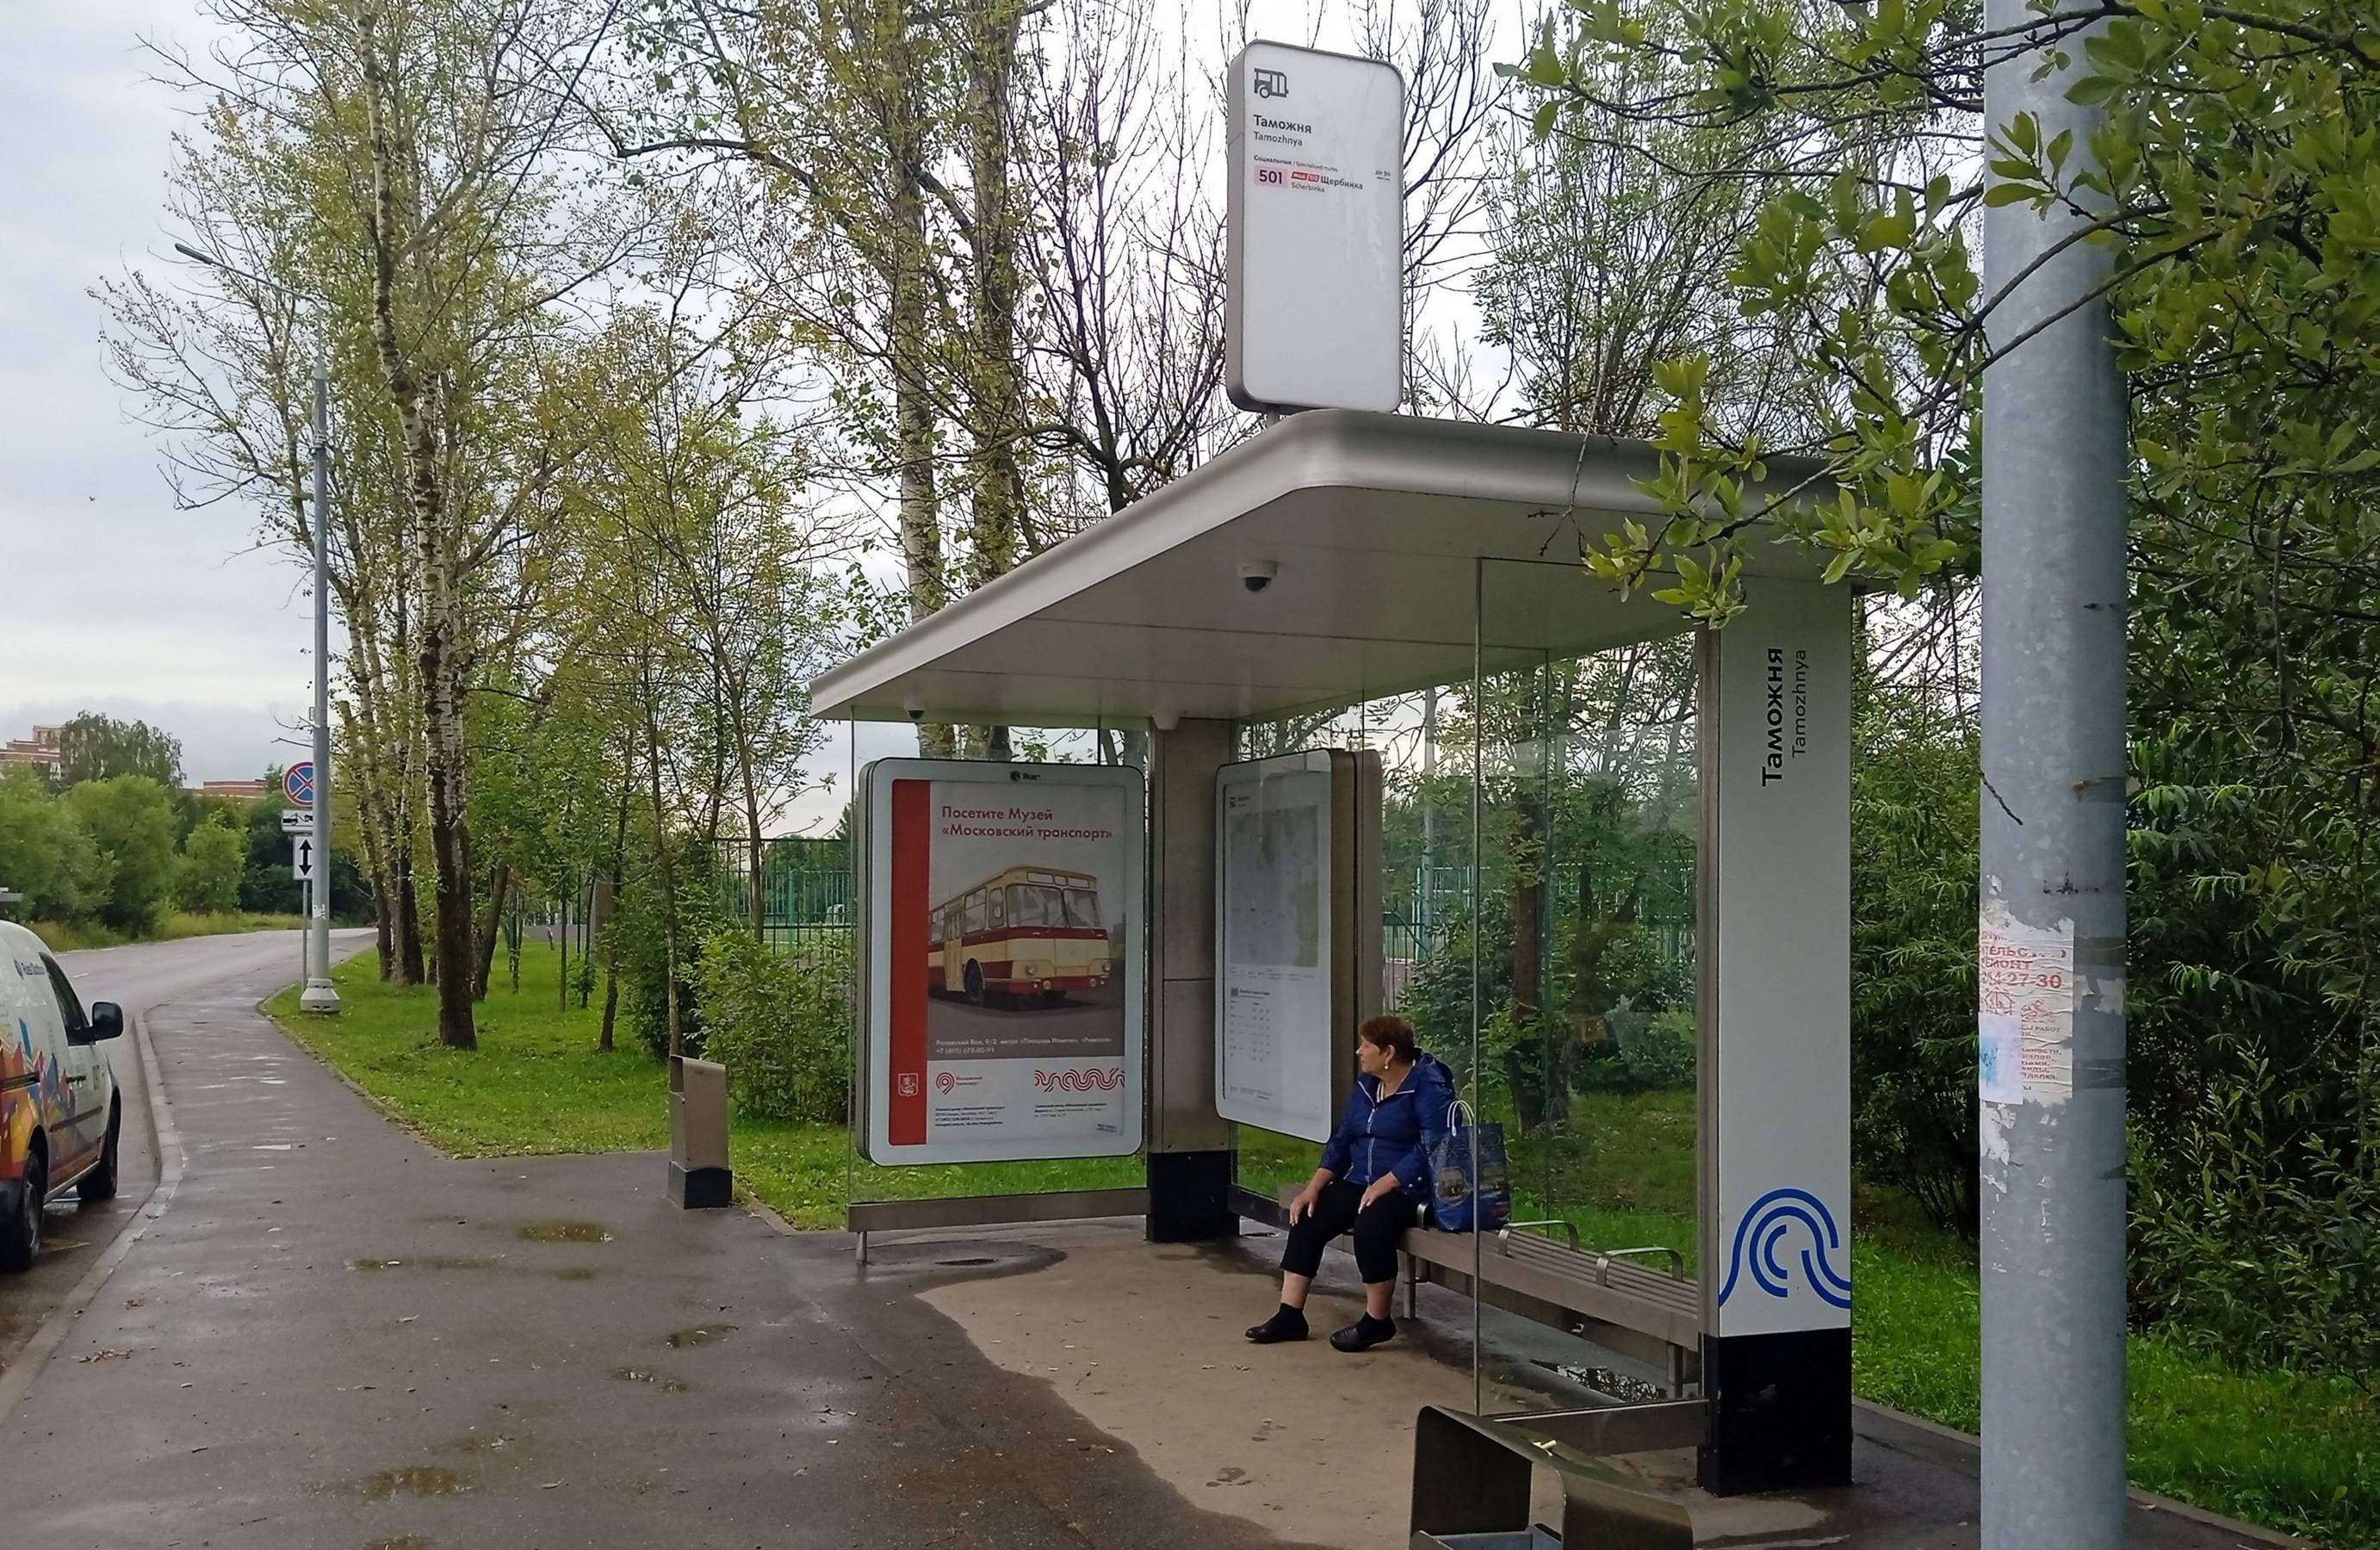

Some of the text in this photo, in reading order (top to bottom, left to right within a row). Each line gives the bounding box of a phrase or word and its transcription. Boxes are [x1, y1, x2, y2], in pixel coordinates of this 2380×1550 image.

[1254, 115, 1311, 133] Таможня
[1254, 131, 1303, 146] Tamozhnya
[1259, 170, 1282, 184] 501
[1321, 176, 1363, 189] Щербинка
[1792, 650, 1808, 758] Tamozhnya
[1762, 648, 1782, 786] Таможня
[942, 806, 1053, 822] Посетите Музей
[942, 824, 1113, 841] «Московский транспорт»
